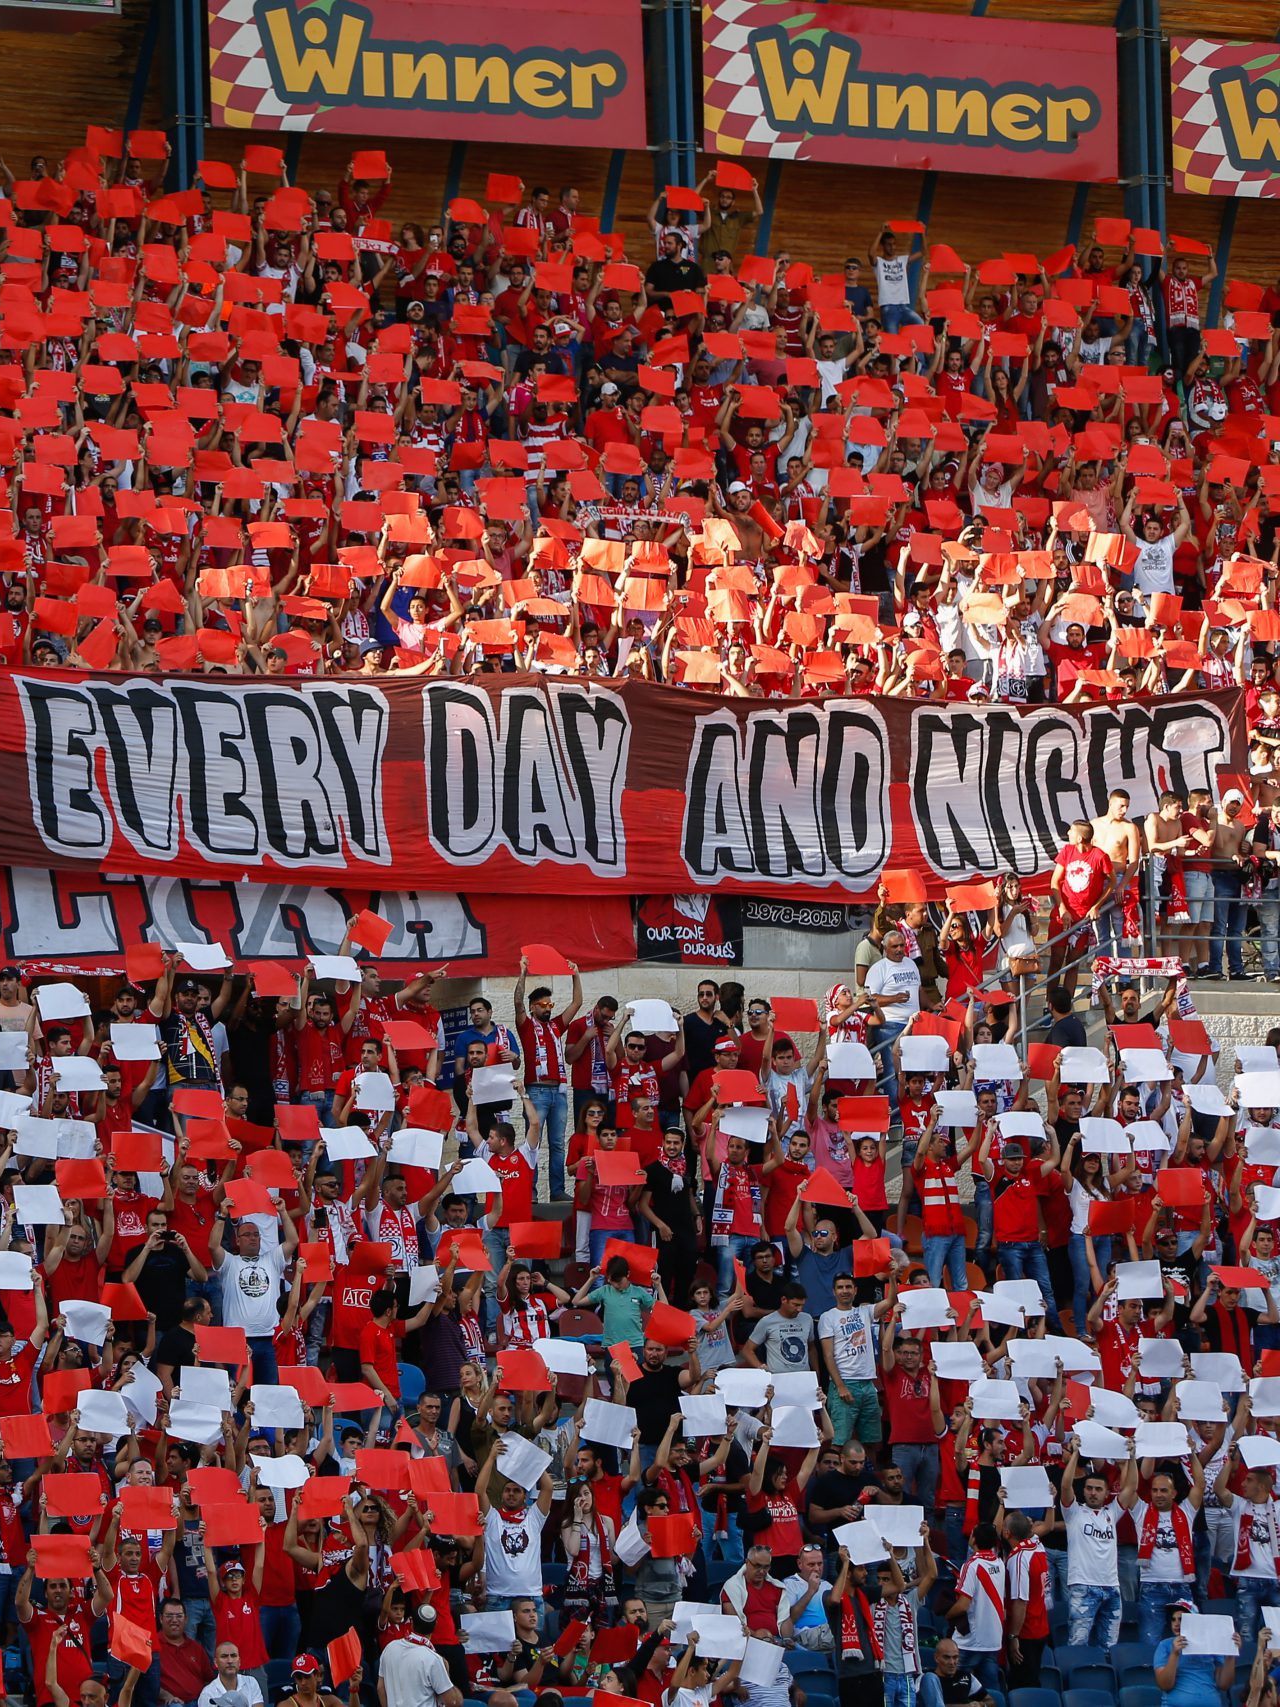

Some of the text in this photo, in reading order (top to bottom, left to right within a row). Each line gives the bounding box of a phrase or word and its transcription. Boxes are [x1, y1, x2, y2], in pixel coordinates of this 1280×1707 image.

[265, 6, 618, 110] Winner
[753, 38, 1092, 144] Winner
[11, 674, 392, 868] EVERY
[423, 679, 631, 877] DAY
[680, 698, 892, 893] AND
[909, 699, 1231, 881] NIGHT
[747, 902, 842, 927] 1978-2013
[646, 924, 705, 942] OUR ZONE
[683, 942, 735, 959] OUR RULES
[345, 1289, 371, 1307] AIG
